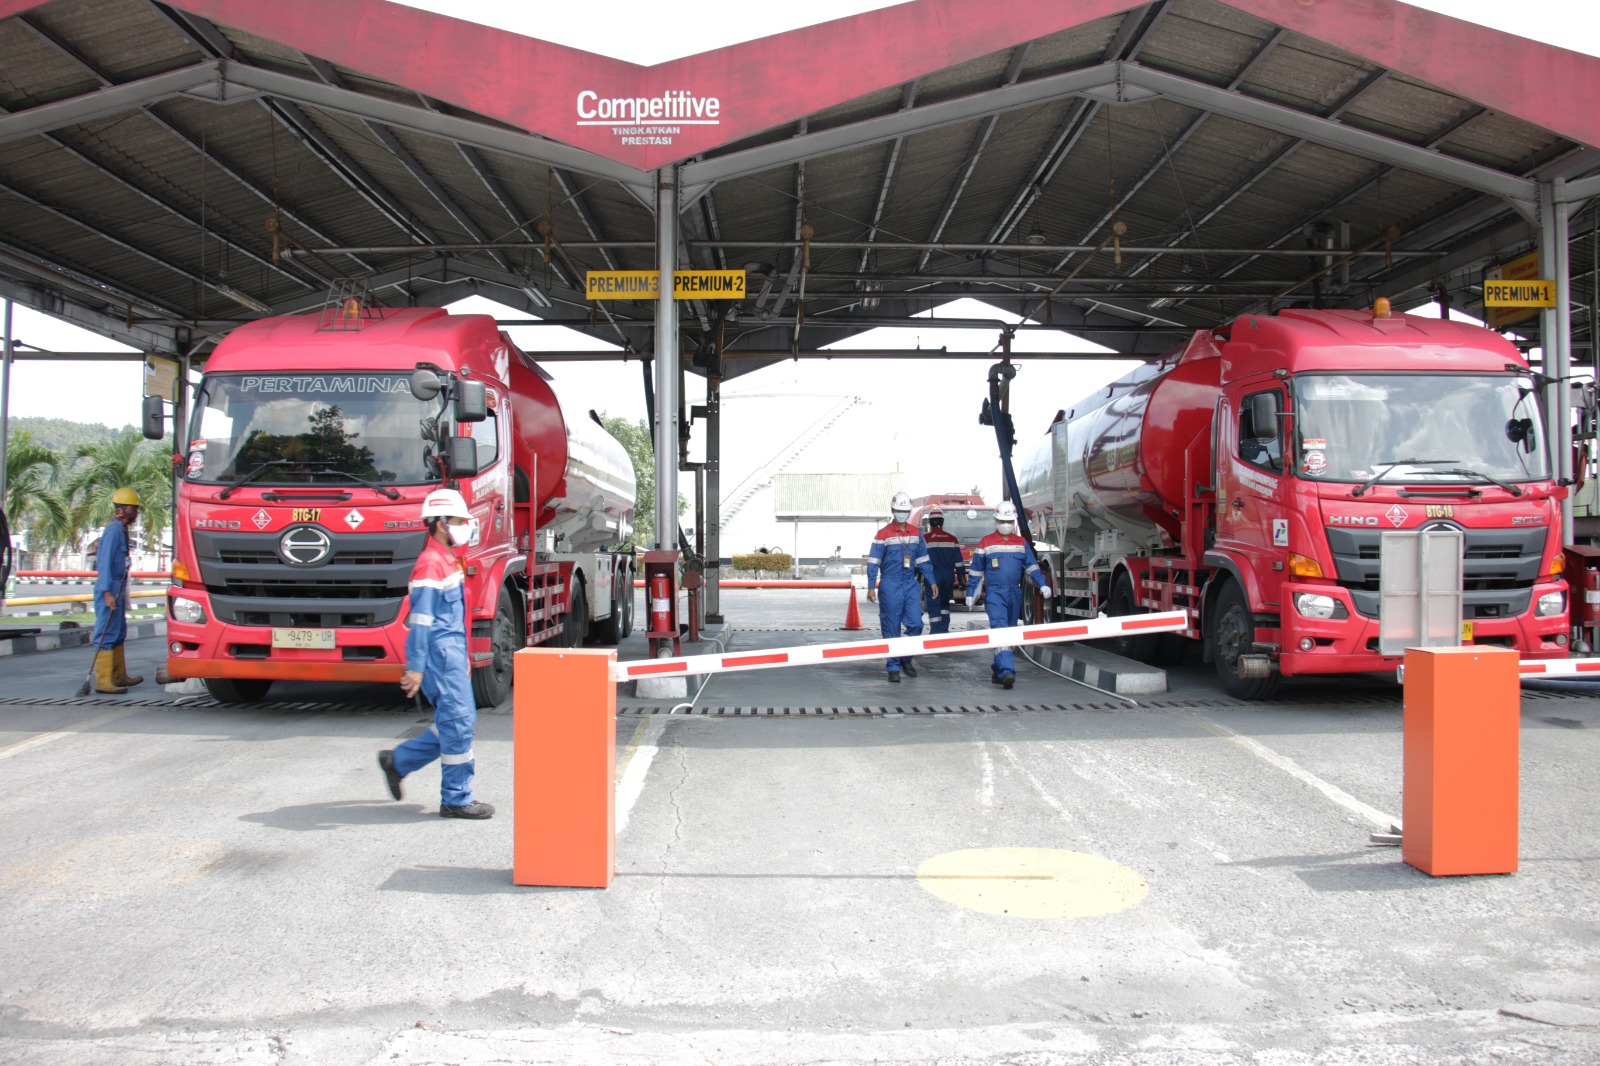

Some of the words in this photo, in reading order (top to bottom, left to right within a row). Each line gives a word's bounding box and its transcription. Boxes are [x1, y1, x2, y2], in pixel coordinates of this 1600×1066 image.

[577, 90, 720, 125] Competitive
[612, 127, 680, 135] TINGKATKAN
[622, 137, 672, 145] PRESTASI
[589, 277, 660, 292] PREMIUM-3
[673, 275, 744, 291] PREMIUM-2
[1486, 286, 1549, 301] PREMIUM-1
[241, 377, 412, 393] PERTAMINA
[292, 508, 322, 521] BTG-17
[1426, 504, 1454, 518] BTG-18
[195, 519, 241, 529] HINO
[1329, 516, 1379, 526] HINO
[273, 630, 280, 642] L
[290, 630, 313, 642] 9479
[321, 630, 333, 642] UR
